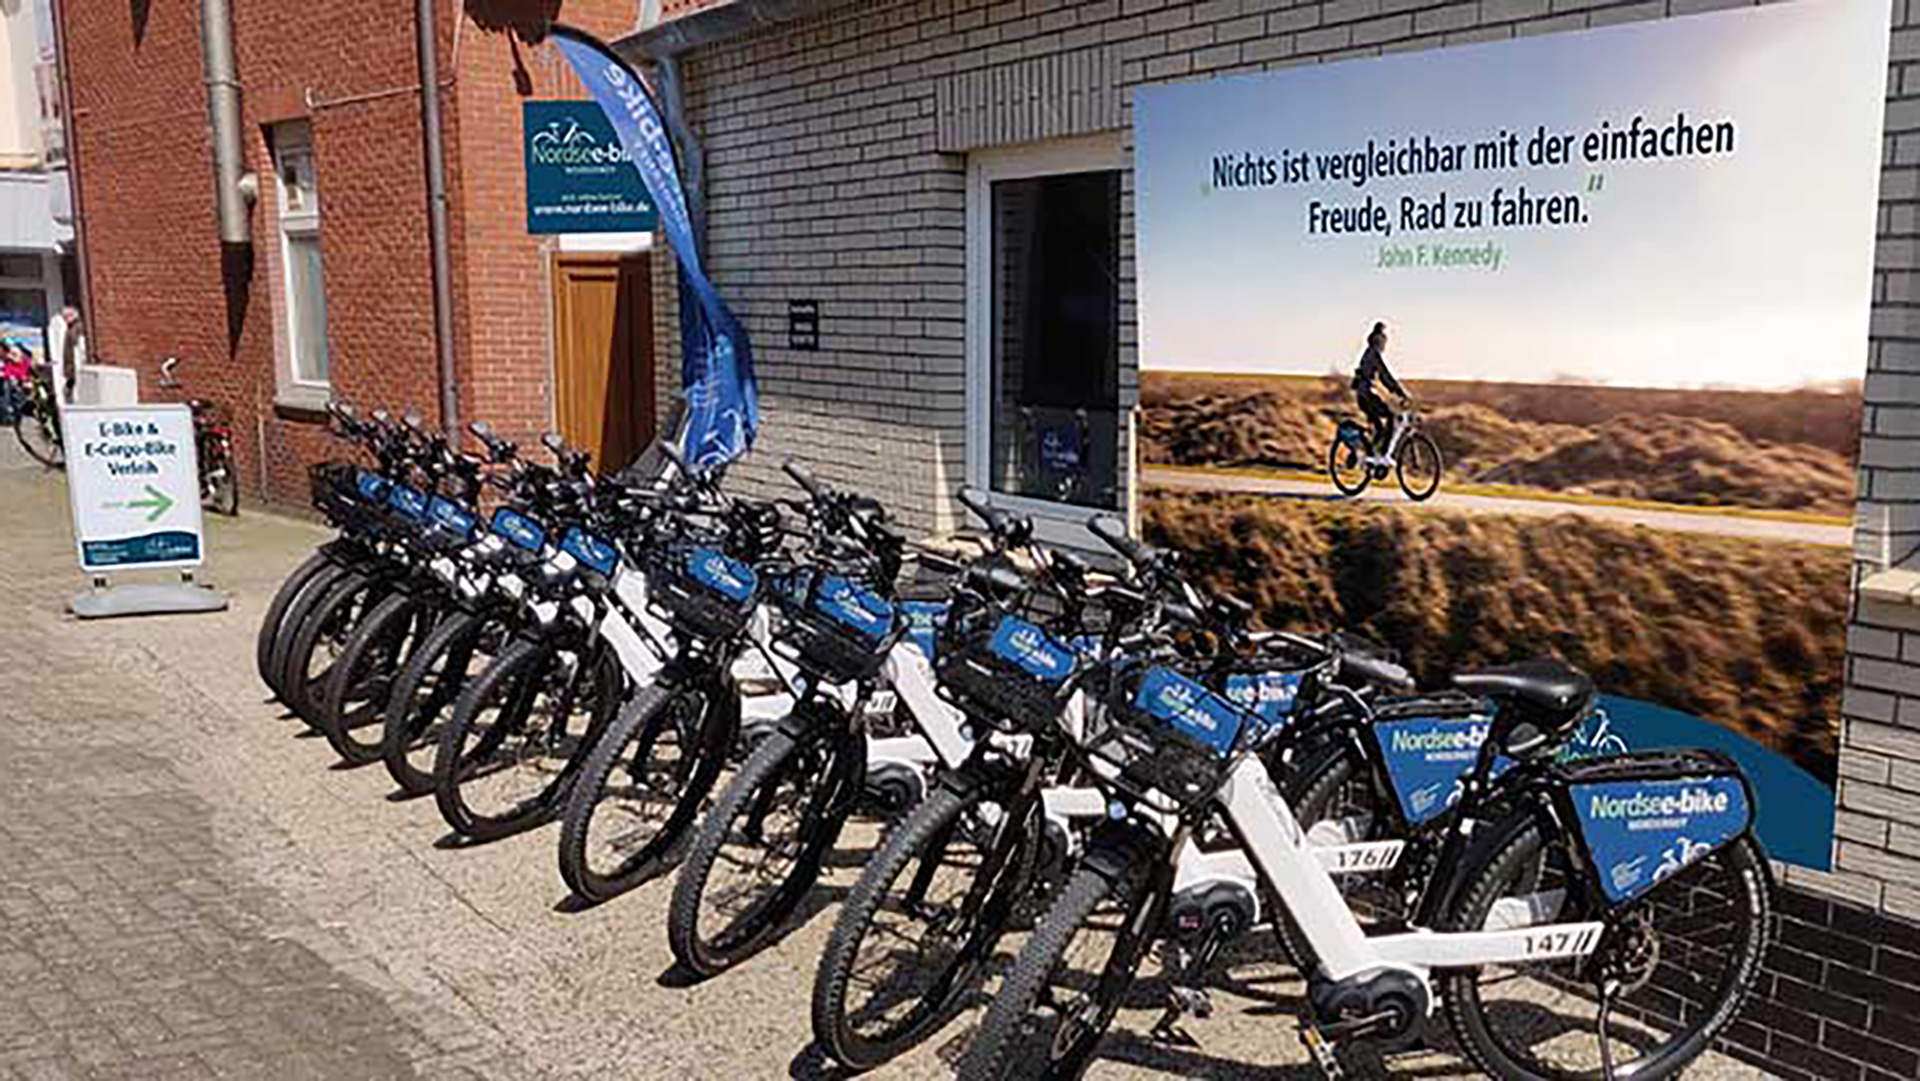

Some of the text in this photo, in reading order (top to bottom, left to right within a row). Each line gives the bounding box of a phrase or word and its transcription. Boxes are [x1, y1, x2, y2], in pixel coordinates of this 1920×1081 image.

[1283, 149, 1309, 182] ist
[1316, 136, 1466, 187] vergleichbar
[1474, 130, 1518, 169] mit
[1527, 126, 1575, 165] der
[1582, 113, 1734, 161] einfachen
[1308, 196, 1391, 236] Freude,
[1400, 192, 1446, 230] Rad
[1453, 202, 1482, 228] zu
[1378, 240, 1502, 271] John F. Kennedy
[99, 422, 159, 436] E-Bike &
[84, 442, 177, 459] E-Cargo-Bike
[107, 461, 159, 475] Verleih
